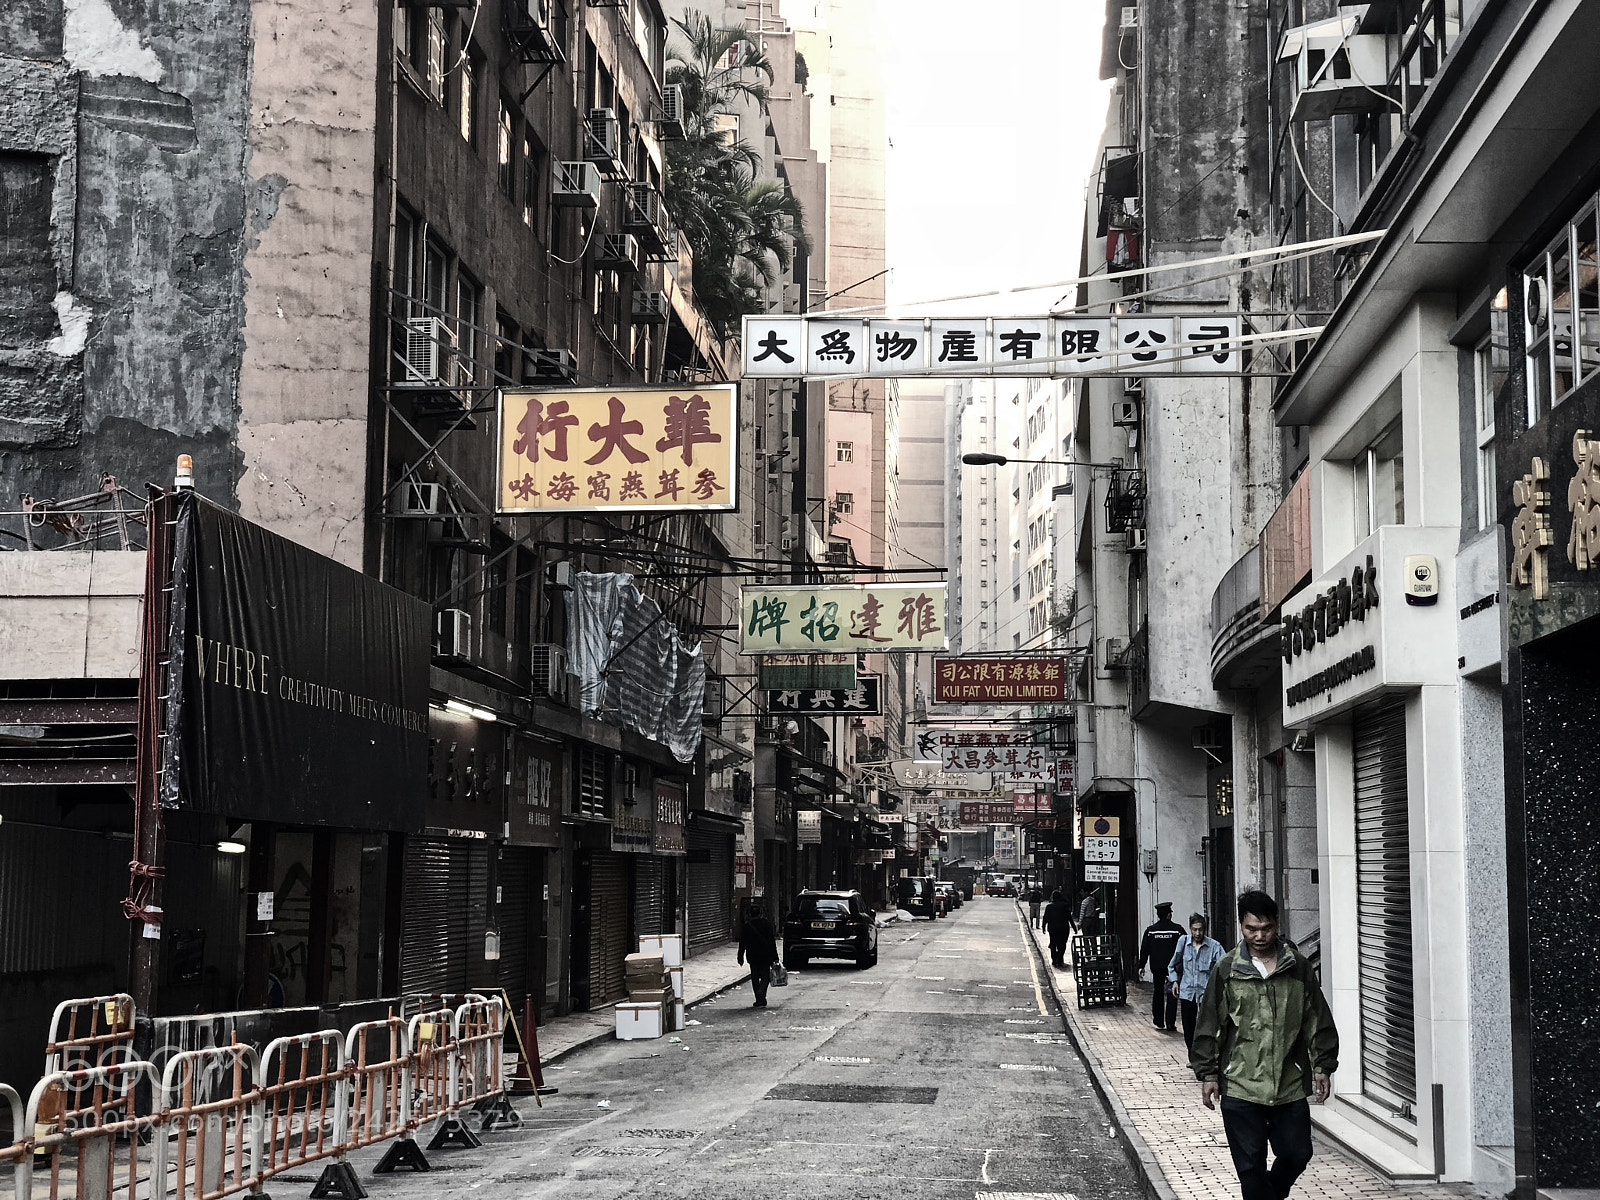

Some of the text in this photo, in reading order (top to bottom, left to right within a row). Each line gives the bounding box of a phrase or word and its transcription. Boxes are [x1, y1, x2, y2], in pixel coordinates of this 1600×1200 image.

[196, 635, 428, 734] WHERE CREATIVITY MEETS COMMERCE
[943, 686, 1058, 697] KUI FAT YUEN LIMITED
